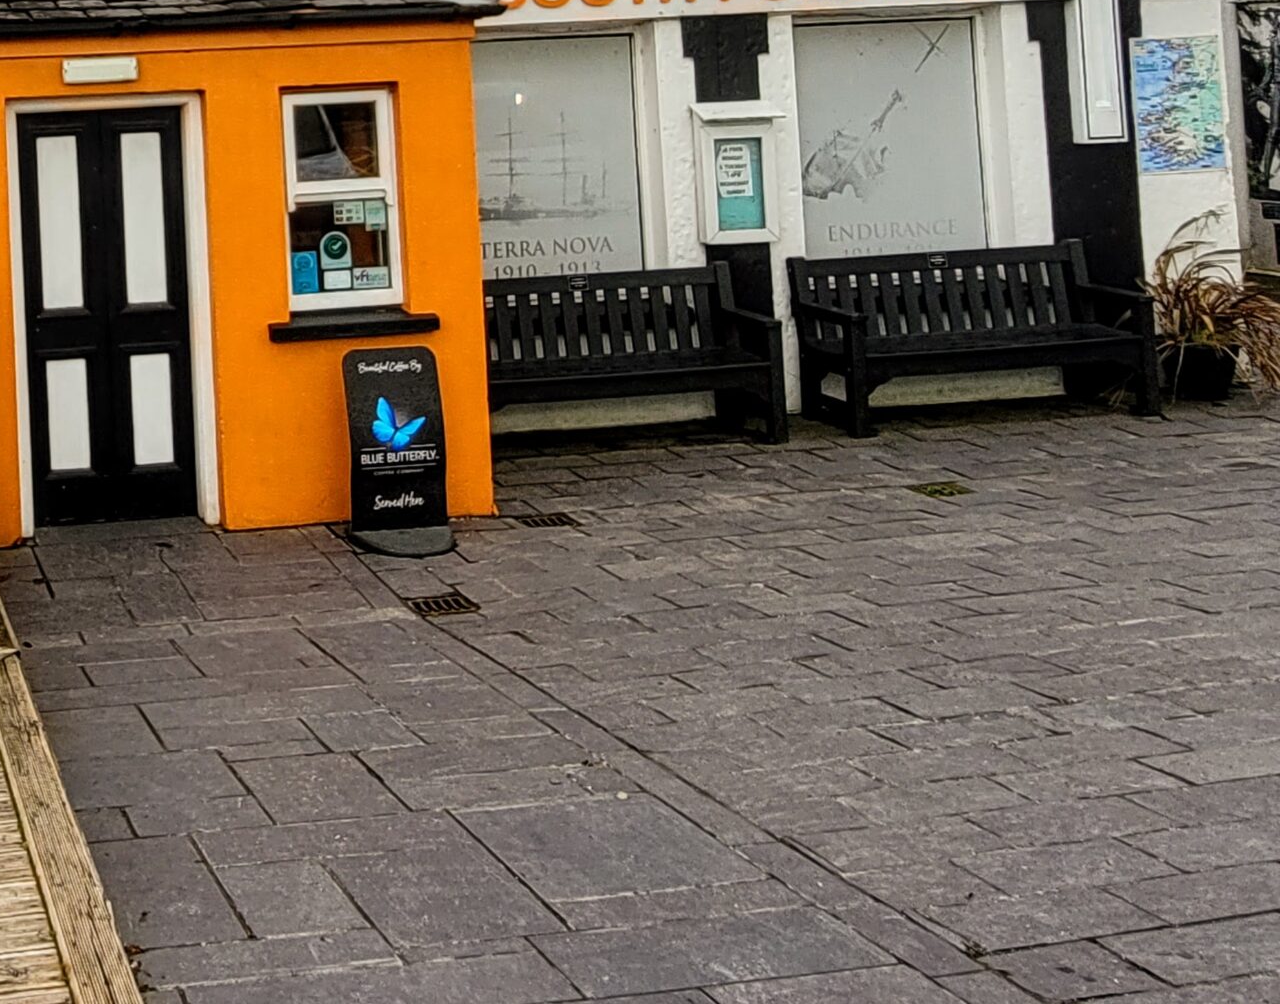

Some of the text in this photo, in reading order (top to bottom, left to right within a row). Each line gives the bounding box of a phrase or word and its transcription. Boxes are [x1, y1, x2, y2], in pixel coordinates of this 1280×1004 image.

[828, 219, 958, 242] ENDURANCE
[480, 236, 613, 260] TERRA NOVA
[409, 359, 422, 373] By
[361, 449, 437, 465] BLUE BUTTERFLY
[373, 490, 425, 510] Served Here
